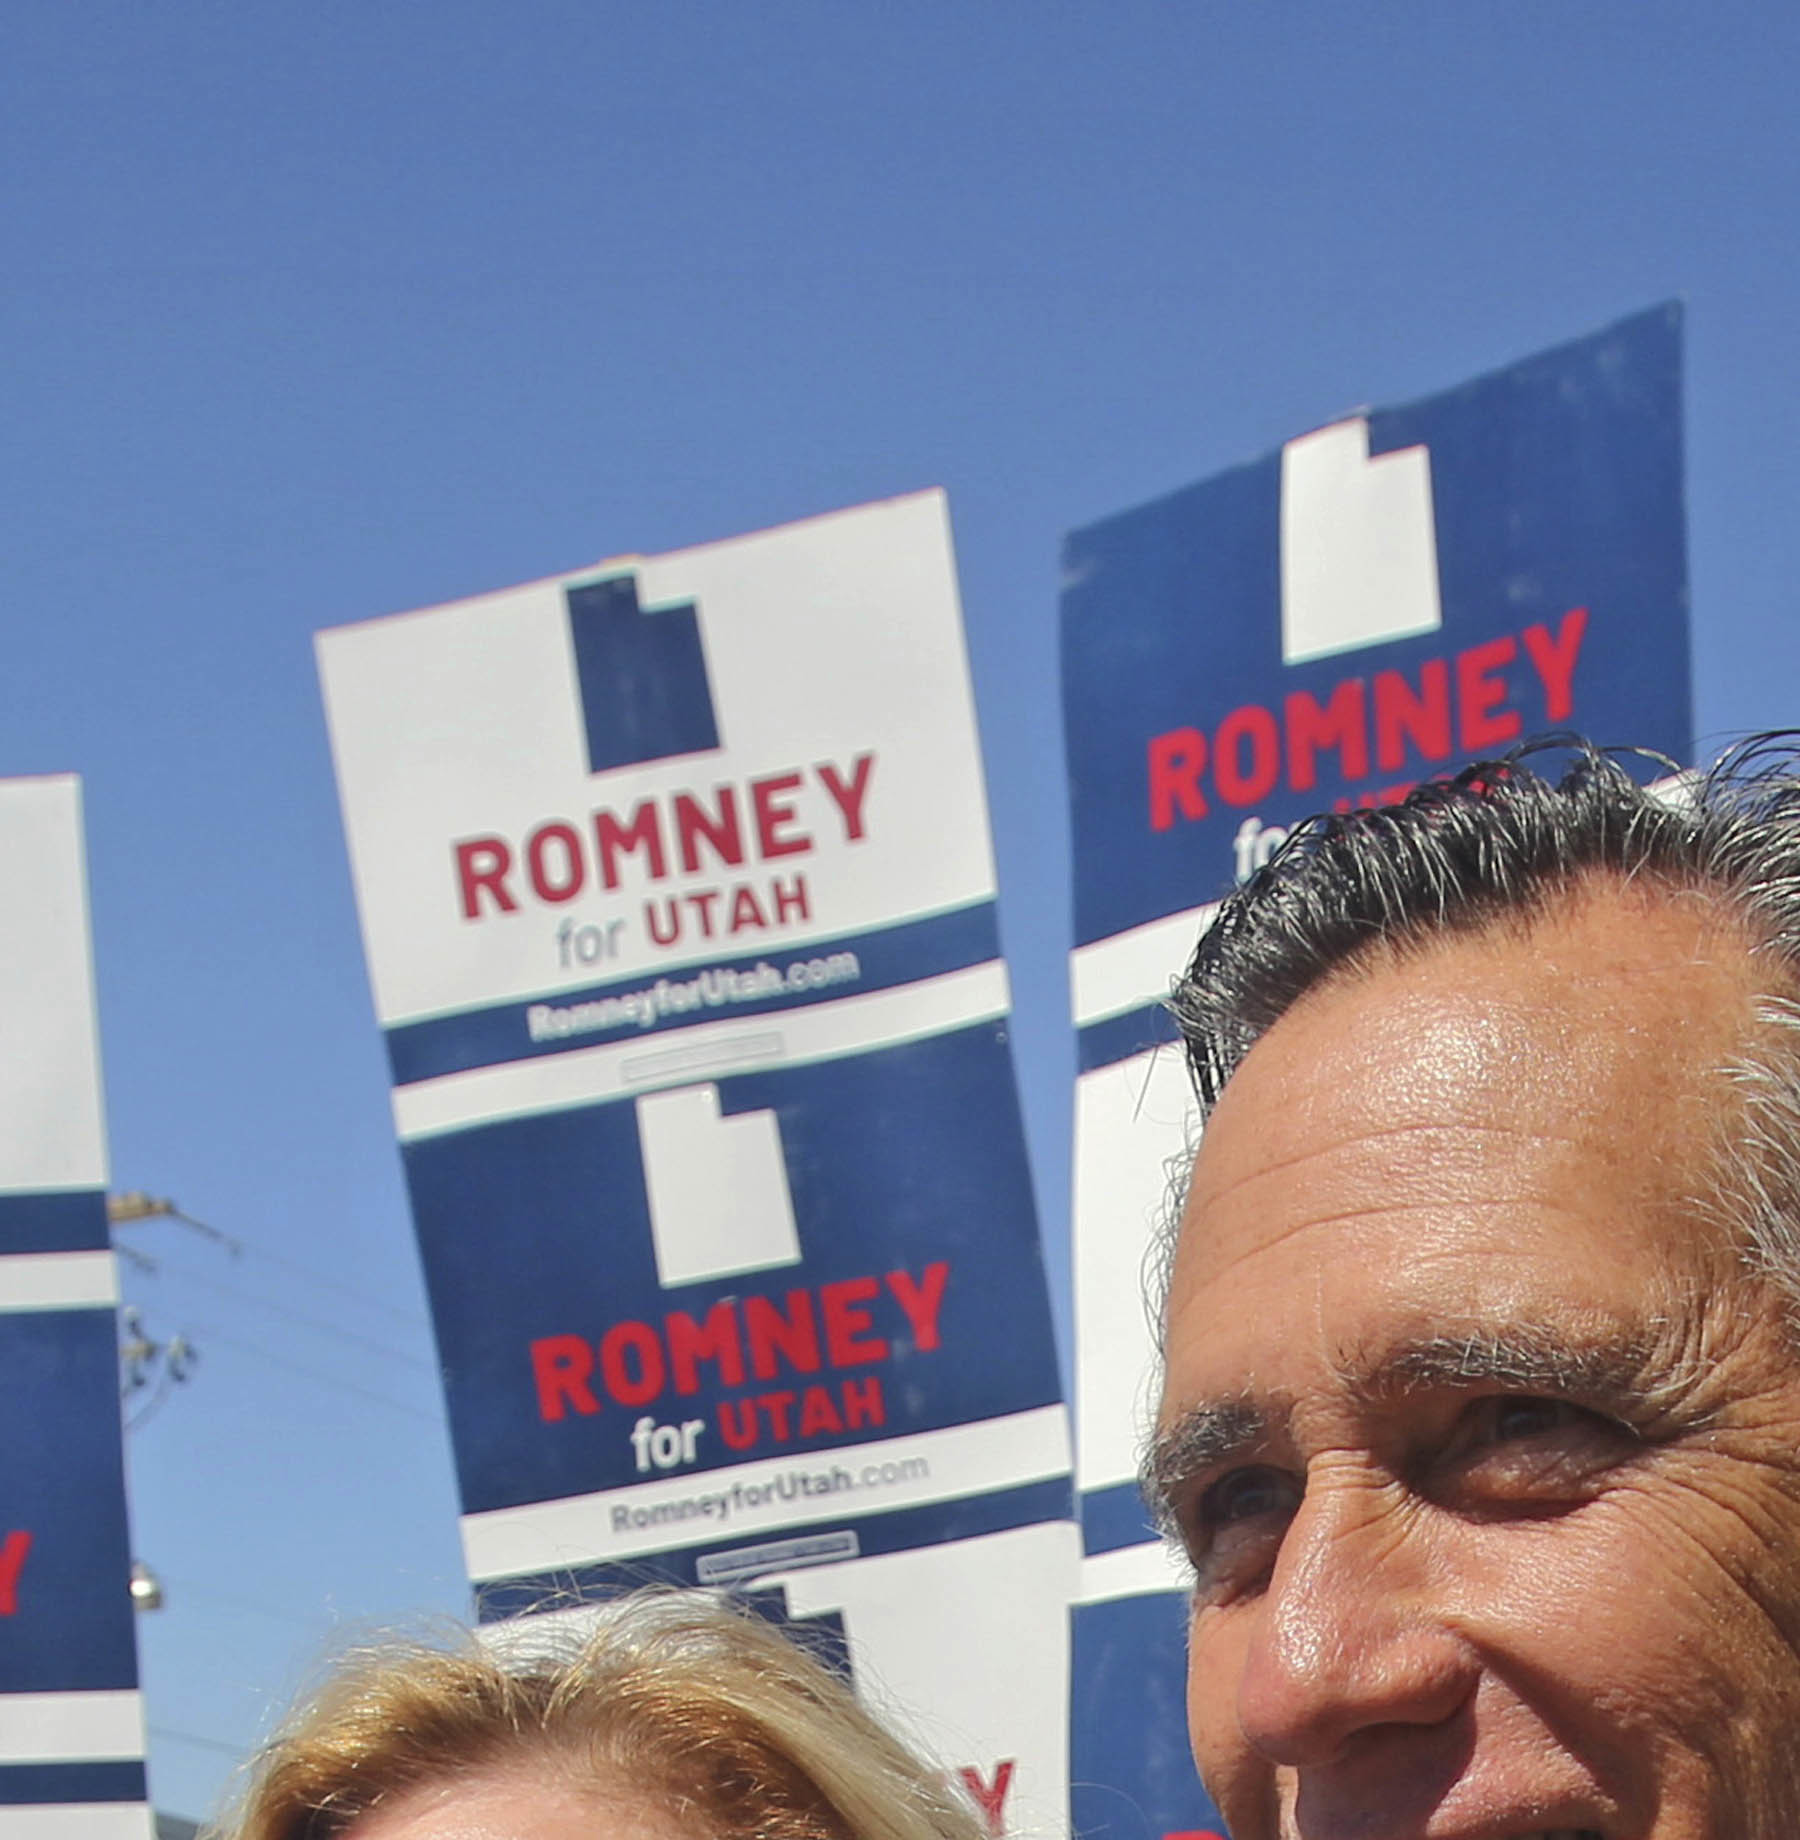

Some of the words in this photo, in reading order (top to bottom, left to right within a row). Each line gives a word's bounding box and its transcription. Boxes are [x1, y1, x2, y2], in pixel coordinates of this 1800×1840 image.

[1146, 606, 1588, 833] ROMNEY
[451, 750, 878, 923] ROMNEY
[554, 913, 627, 969] for
[644, 874, 814, 948] UTAH
[526, 949, 860, 1042] RomneyforUtah.com
[529, 1262, 951, 1422] ROMNEY
[629, 1416, 705, 1473] for
[717, 1377, 888, 1452] UTAH
[611, 1454, 930, 1534] RomneyforUtah.com
